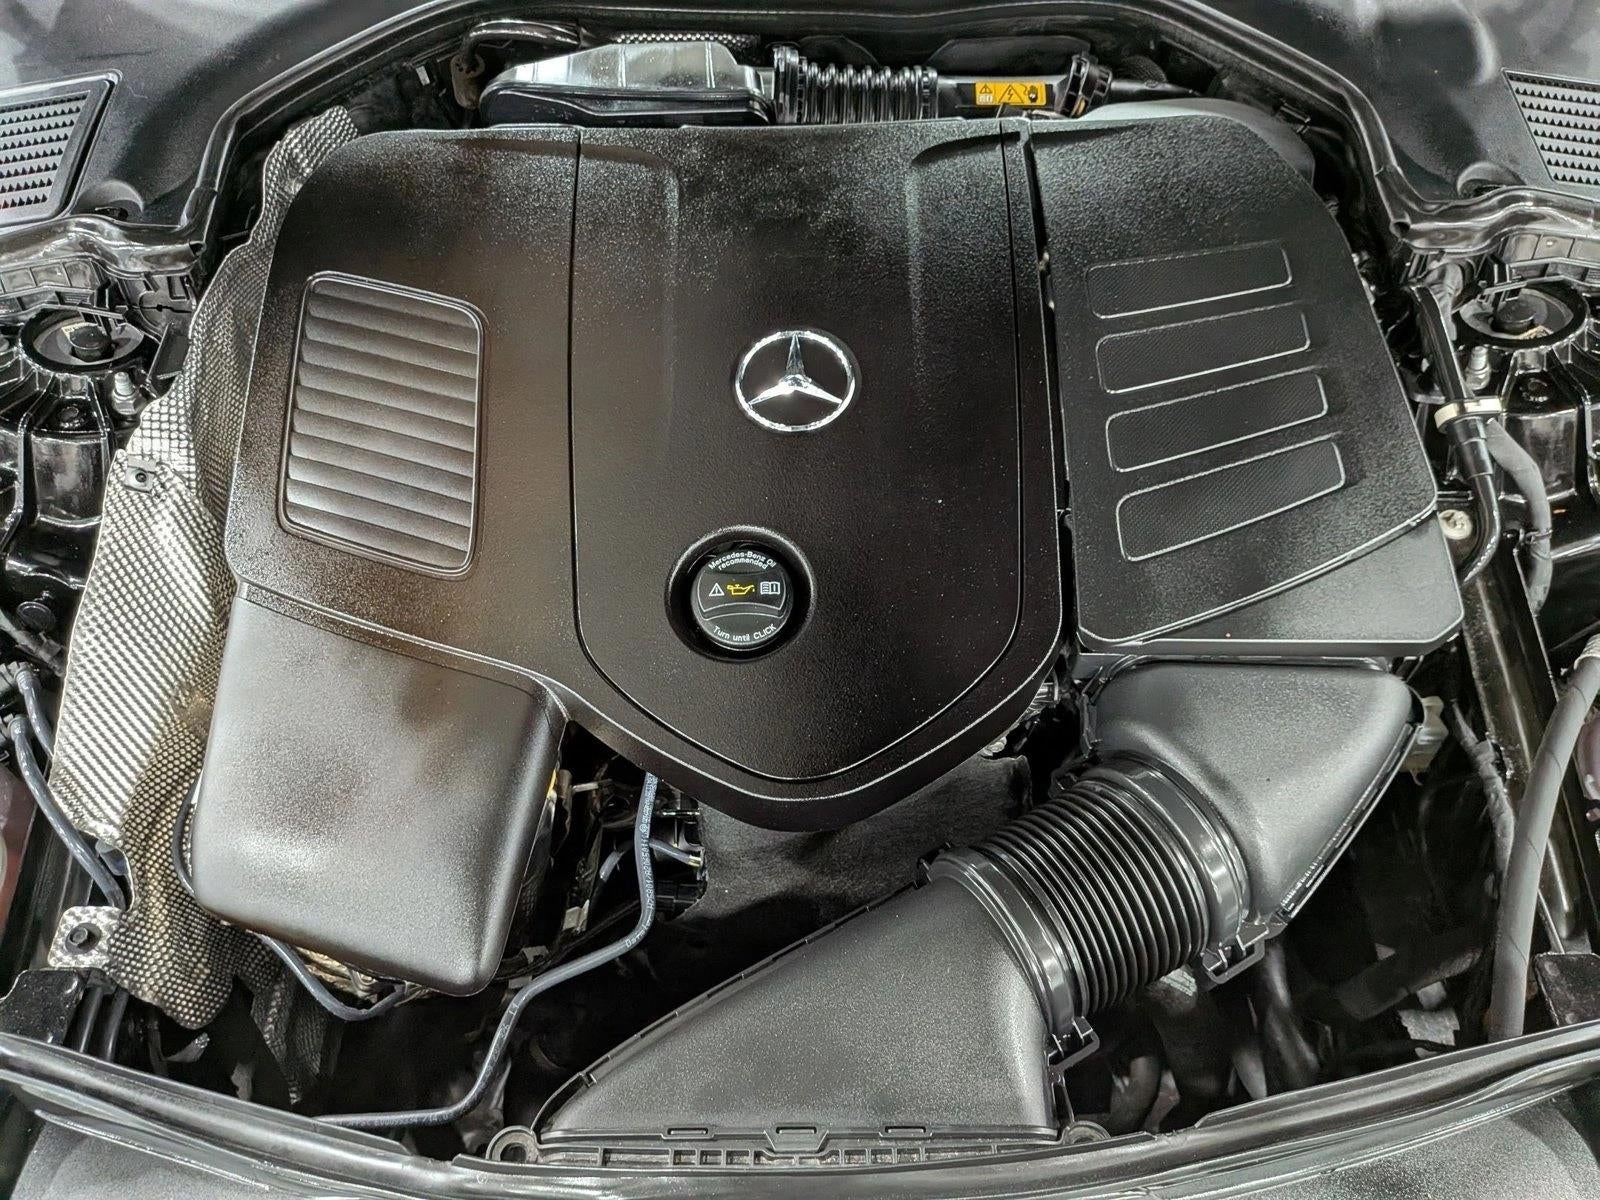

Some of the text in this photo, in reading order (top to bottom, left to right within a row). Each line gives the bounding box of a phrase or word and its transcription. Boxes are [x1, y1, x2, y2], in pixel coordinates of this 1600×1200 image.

[708, 551, 777, 569] Mercedes-Benz Oil
[718, 557, 768, 570] recommended
[713, 623, 777, 642] Turn until CLICK
